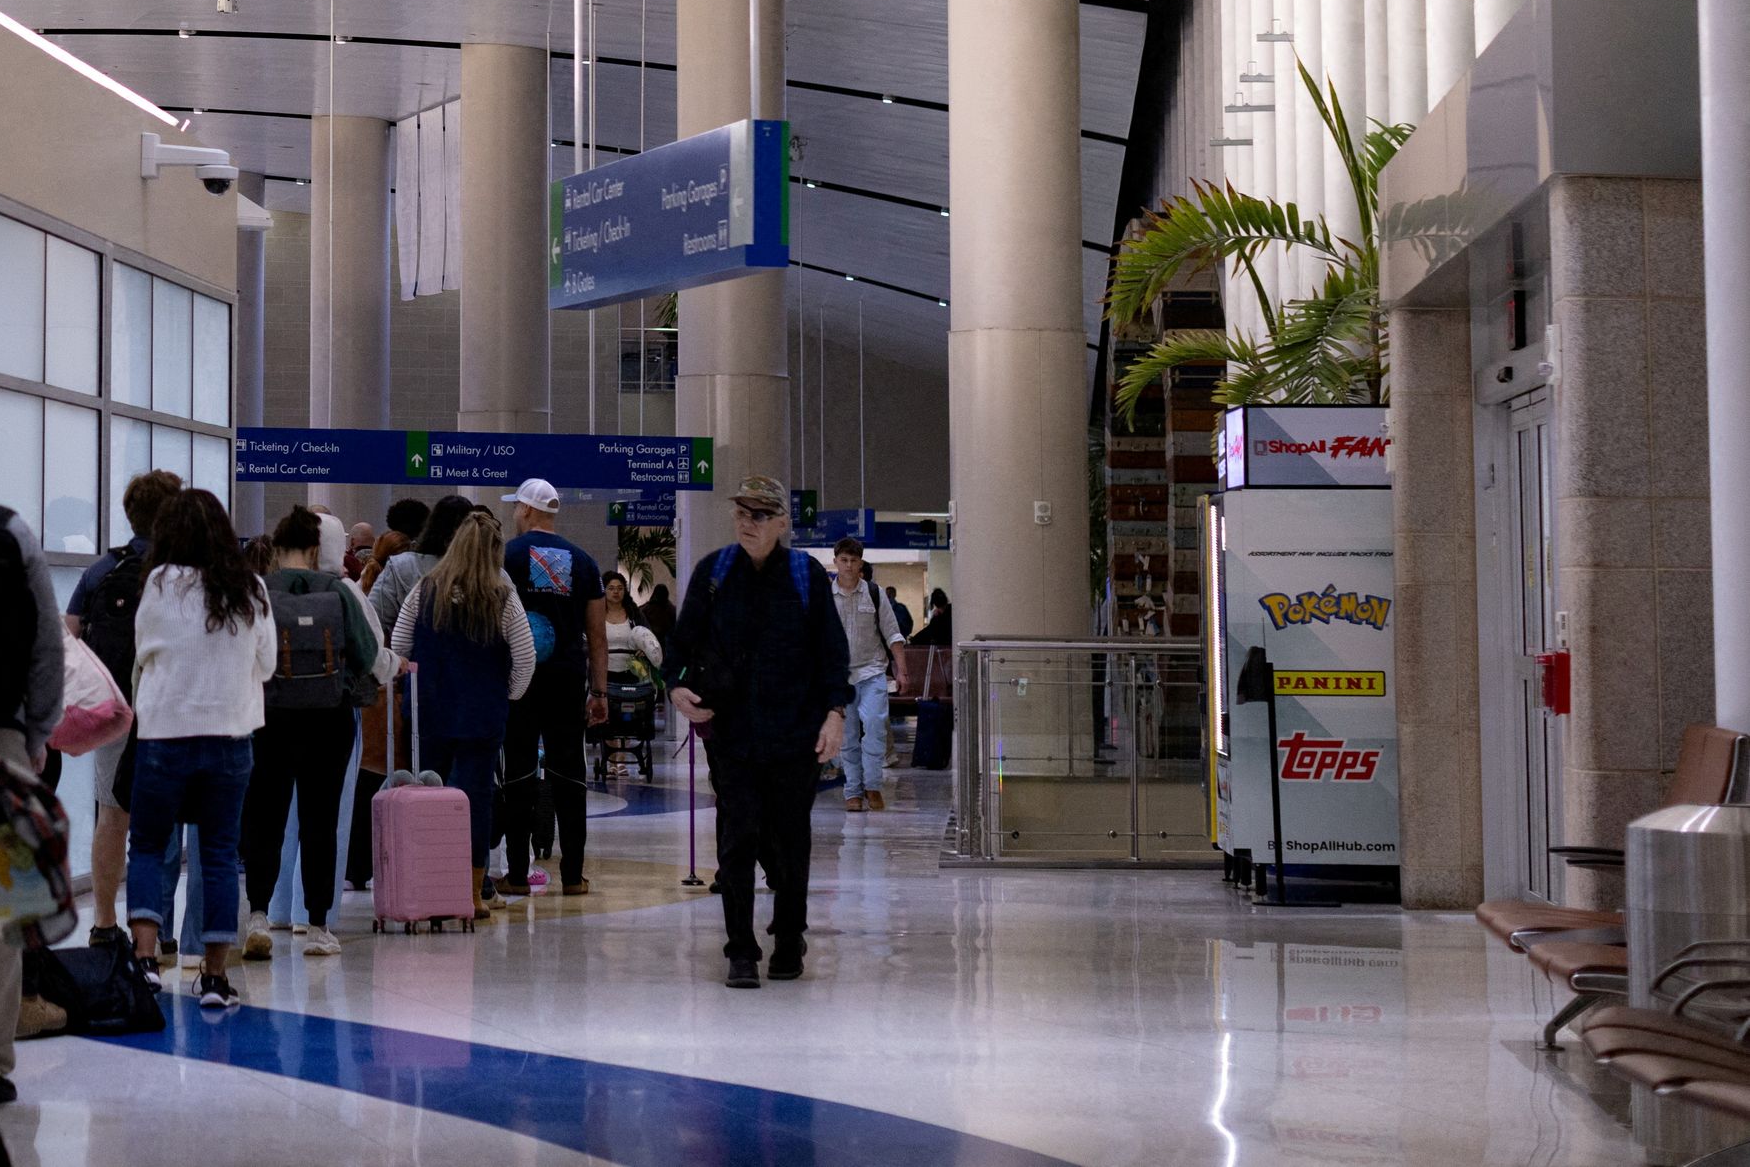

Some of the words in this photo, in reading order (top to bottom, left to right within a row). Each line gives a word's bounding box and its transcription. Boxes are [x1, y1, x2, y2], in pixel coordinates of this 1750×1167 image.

[573, 182, 590, 210] Rental
[591, 182, 603, 204] Car
[603, 178, 625, 200] Center
[661, 183, 687, 212] Parking
[687, 180, 718, 206] Garages
[572, 227, 598, 253] Ticketing
[604, 215, 631, 243] Check-In
[683, 233, 717, 256] Restrooms
[577, 271, 595, 293] Gates
[250, 441, 289, 455] Ticketing
[292, 442, 299, 454] /
[301, 442, 340, 453] Check-In
[446, 444, 481, 457] Military
[483, 444, 490, 456] /
[493, 445, 515, 456] USO
[599, 443, 634, 455] Parking
[636, 444, 676, 456] Garages
[1268, 439, 1327, 456] ShopAll
[249, 463, 277, 474] Rental
[281, 464, 297, 475] Car
[300, 464, 330, 475] Center
[627, 459, 664, 470] Terminal
[666, 460, 674, 469] A
[446, 468, 469, 478] Meet
[471, 468, 480, 478] &
[482, 468, 508, 479] Greet
[630, 472, 675, 482] Restrooms
[636, 503, 658, 511] Rental
[658, 503, 671, 511] Car
[1276, 676, 1377, 690] PANINI
[1286, 840, 1396, 853] ShopAllHub.com
